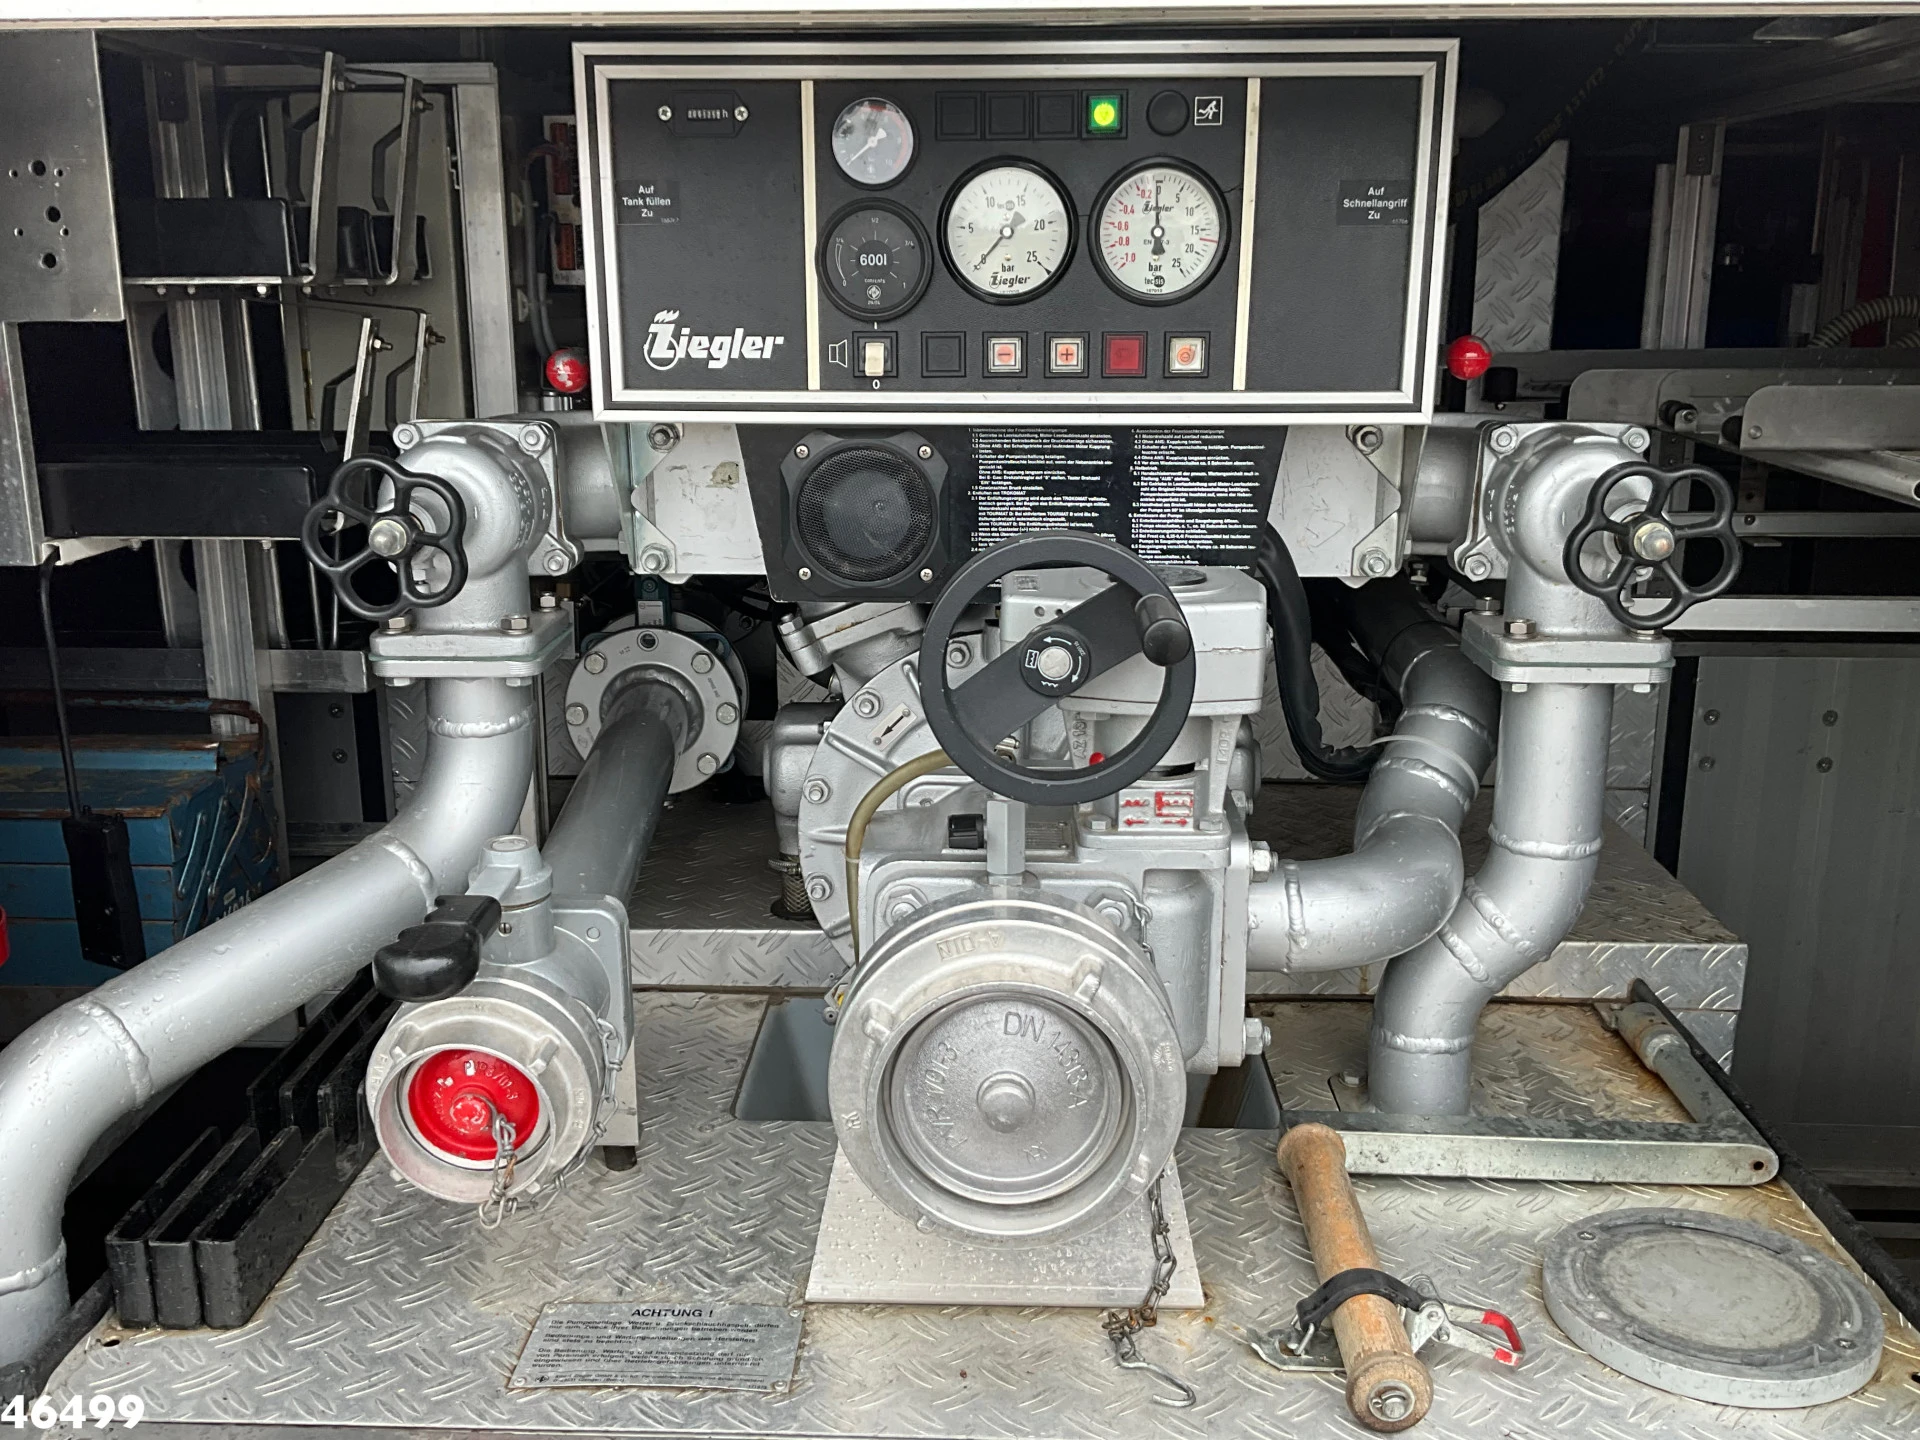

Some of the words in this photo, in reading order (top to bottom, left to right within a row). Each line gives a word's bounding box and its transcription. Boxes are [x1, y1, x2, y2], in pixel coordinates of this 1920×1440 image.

[638, 184, 654, 194] Auf
[1136, 189, 1152, 199] -0.2
[1368, 186, 1385, 196] Auf
[622, 196, 644, 206] Tank
[646, 196, 671, 206] füllen
[986, 196, 995, 208] 10
[1016, 194, 1026, 206] 15
[1176, 193, 1180, 203] 5
[1343, 198, 1408, 210] Schnellangriff
[641, 208, 653, 217] Zu
[1120, 205, 1135, 214] -0.4
[1185, 207, 1194, 217] 10
[1368, 210, 1380, 220] Zu
[968, 222, 974, 233] 5
[1034, 219, 1045, 231] 20
[1113, 221, 1129, 231] -0.6
[1191, 225, 1200, 235] 15
[1114, 236, 1130, 246] -0.8
[1185, 243, 1194, 253] 20
[1026, 251, 1038, 263] 25
[1120, 253, 1136, 262] -1.0
[1001, 263, 1014, 272] bar
[1148, 262, 1162, 272] bar
[1172, 258, 1181, 268] 25
[989, 272, 1030, 289] Ziegler
[643, 311, 785, 370] Ziegler
[872, 379, 880, 390] 0
[1004, 1012, 1045, 1042] DIN
[631, 1308, 703, 1318] ACHTUNG
